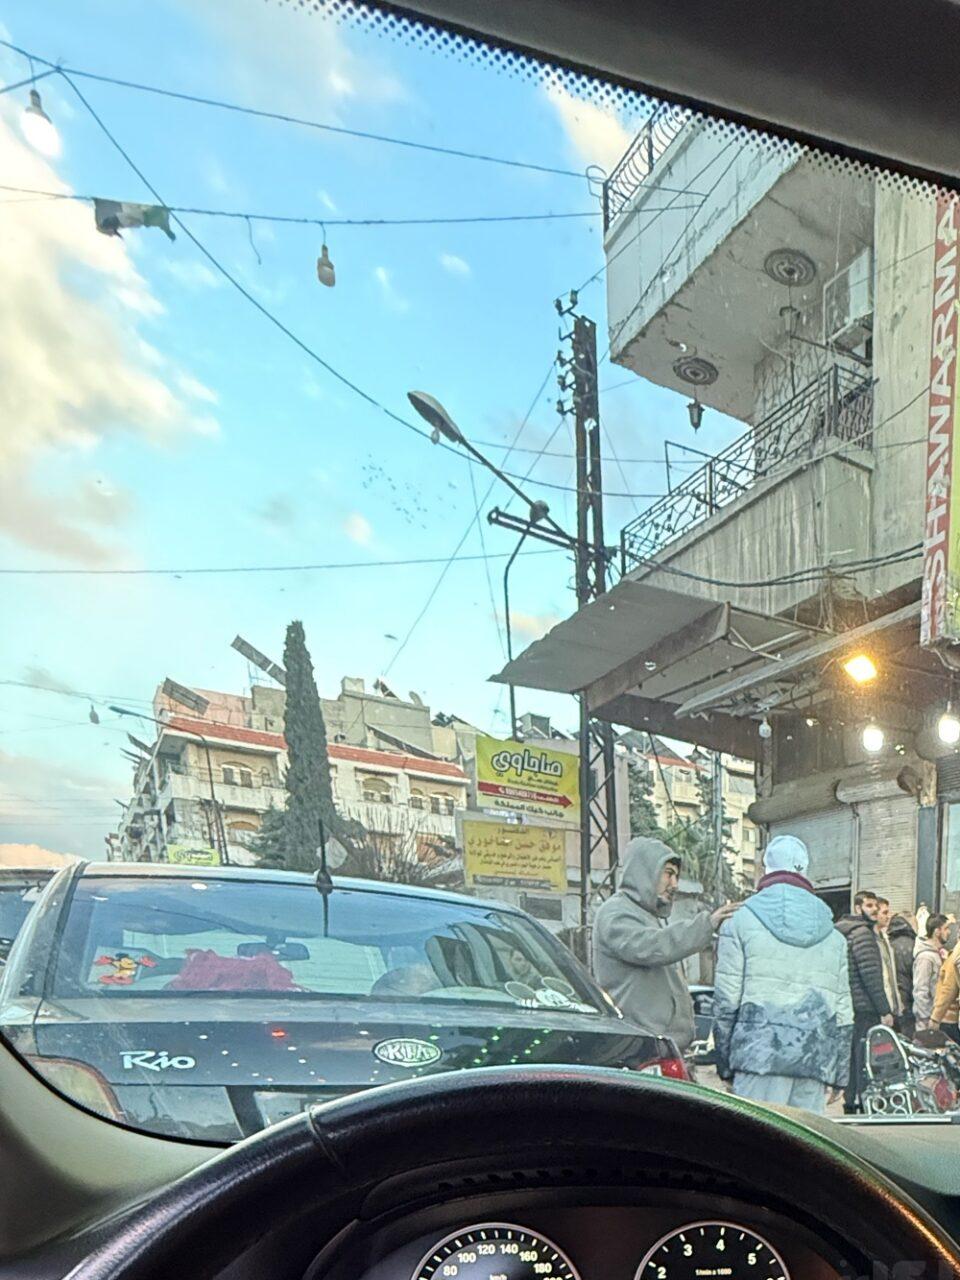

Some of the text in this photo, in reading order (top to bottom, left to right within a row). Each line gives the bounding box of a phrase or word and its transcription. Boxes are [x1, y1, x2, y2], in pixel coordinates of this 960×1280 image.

[120, 1050, 196, 1071] Rio
[477, 1244, 496, 1255] 120
[500, 1244, 519, 1255] 140
[683, 1245, 693, 1256] 3
[716, 1240, 725, 1251] 4
[458, 1252, 477, 1263] 100
[519, 1251, 538, 1262] 160
[748, 1254, 757, 1265] 5
[443, 1265, 458, 1277] 80
[533, 1263, 552, 1274] 180
[657, 1267, 667, 1279] 2
